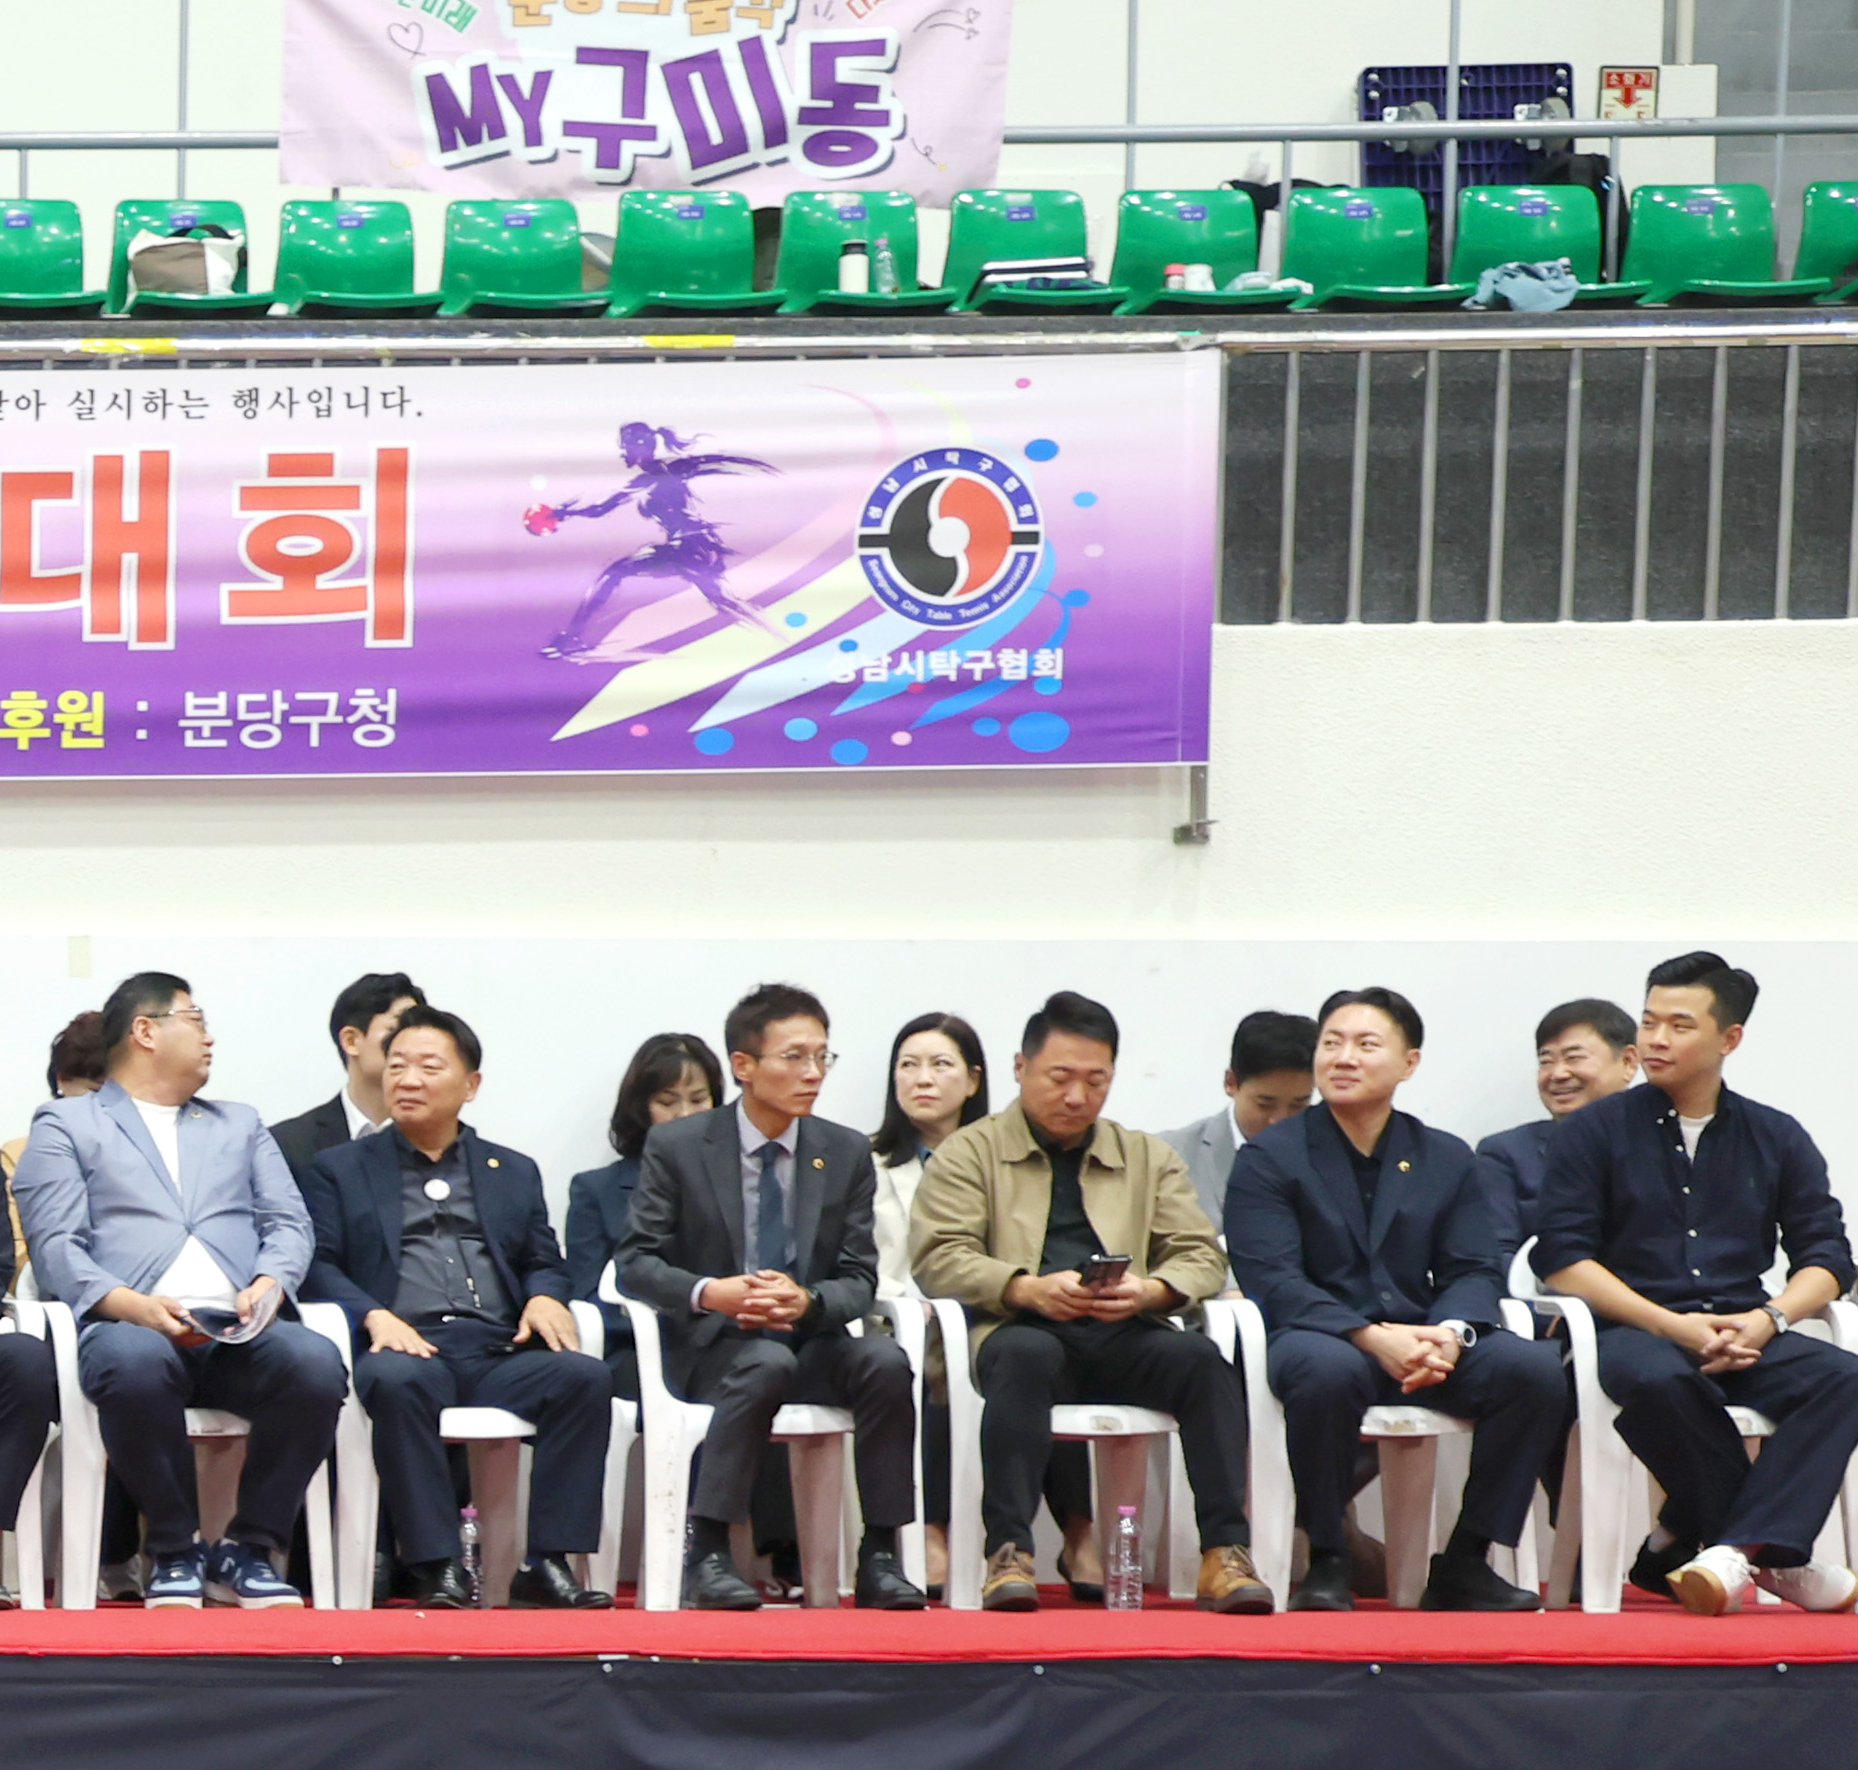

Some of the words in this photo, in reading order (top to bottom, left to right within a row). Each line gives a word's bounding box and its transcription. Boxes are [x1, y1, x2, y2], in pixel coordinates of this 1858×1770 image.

[68, 388, 211, 421] 실시하는
[232, 385, 423, 421] 행사입니다.
[926, 609, 953, 621] Table
[177, 687, 400, 750] 분당구청
